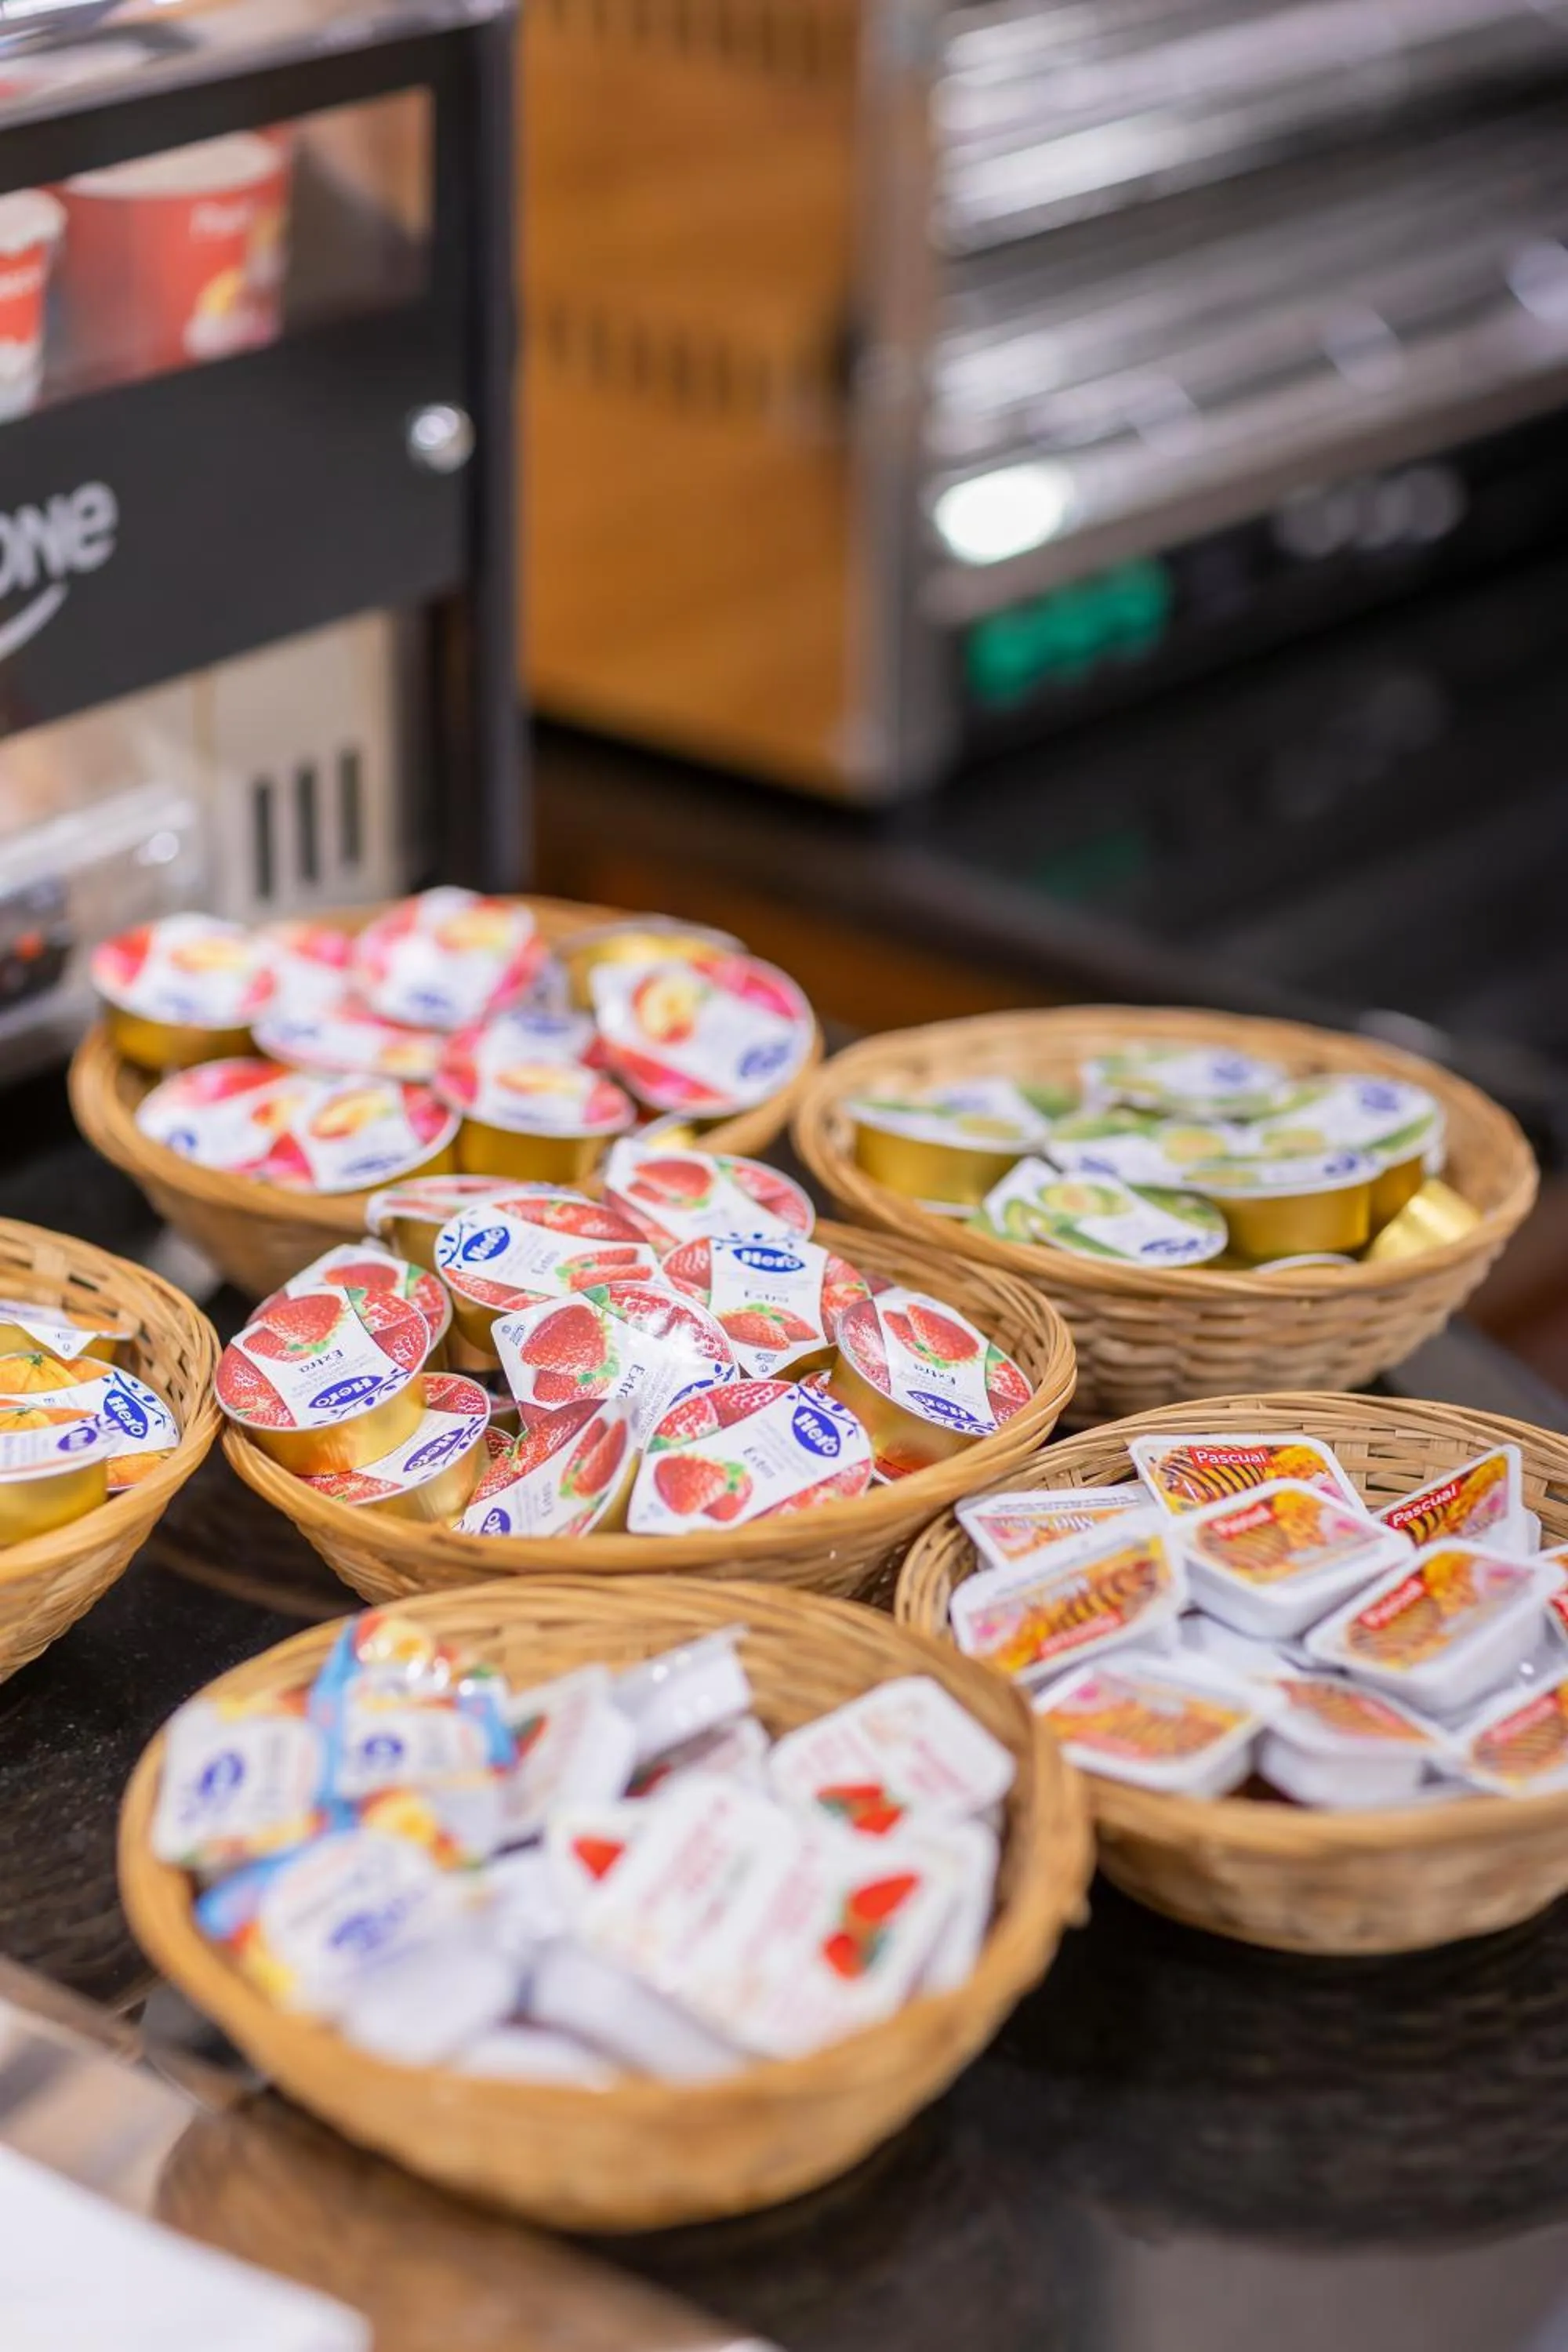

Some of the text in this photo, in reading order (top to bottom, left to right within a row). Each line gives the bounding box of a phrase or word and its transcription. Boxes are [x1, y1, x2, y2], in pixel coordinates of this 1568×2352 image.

[741, 1250, 801, 1269] Hero
[299, 1349, 344, 1373] Extra
[314, 1377, 374, 1407] Hero
[913, 1393, 969, 1419] Hero
[106, 1395, 144, 1436] Hero
[794, 1412, 838, 1455] Hero
[1196, 1450, 1266, 1465] Pascual
[1392, 1483, 1457, 1528] Pascual
